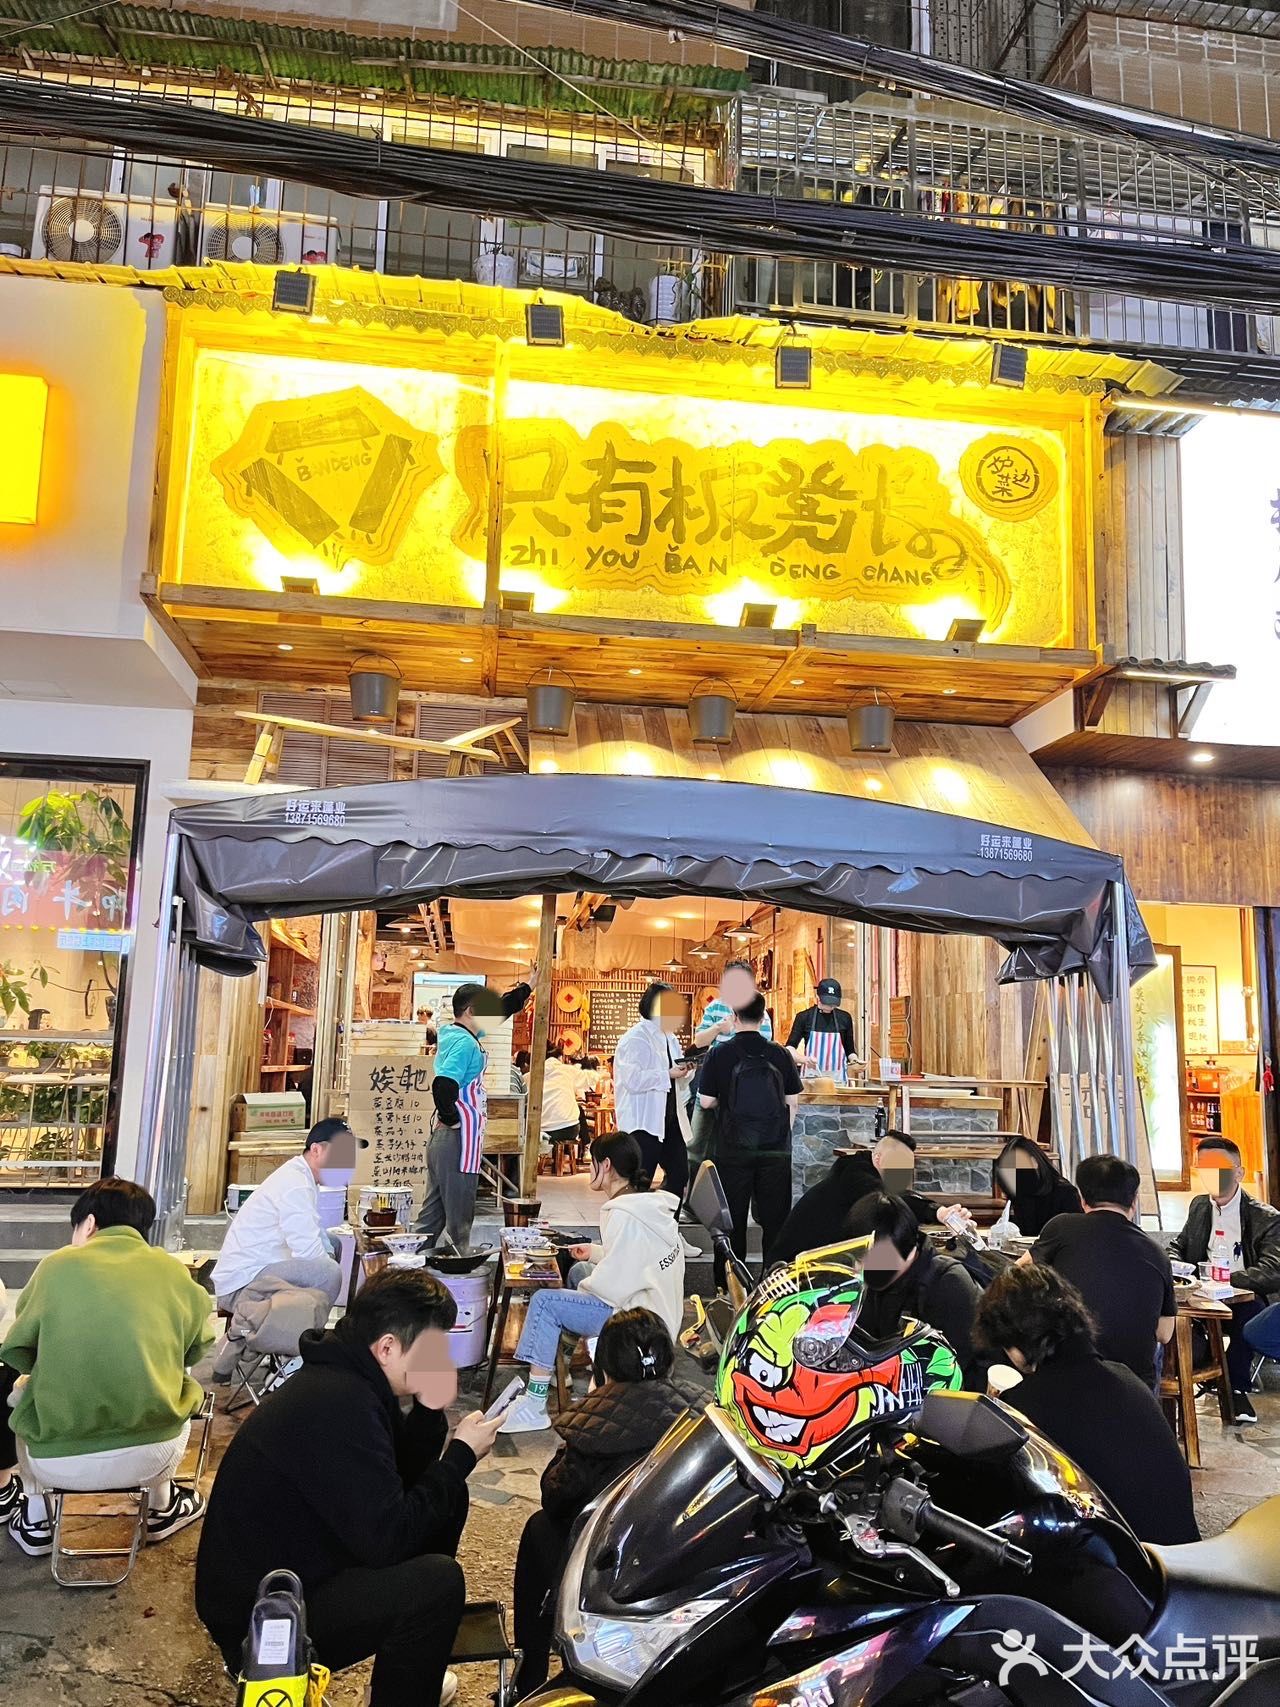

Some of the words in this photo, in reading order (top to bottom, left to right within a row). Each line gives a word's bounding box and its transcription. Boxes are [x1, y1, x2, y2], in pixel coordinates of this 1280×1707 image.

[285, 812, 346, 827] 13871569680
[980, 847, 1033, 862] 13871569680
[410, 1100, 420, 1108] 10
[413, 1114, 422, 1122] 10
